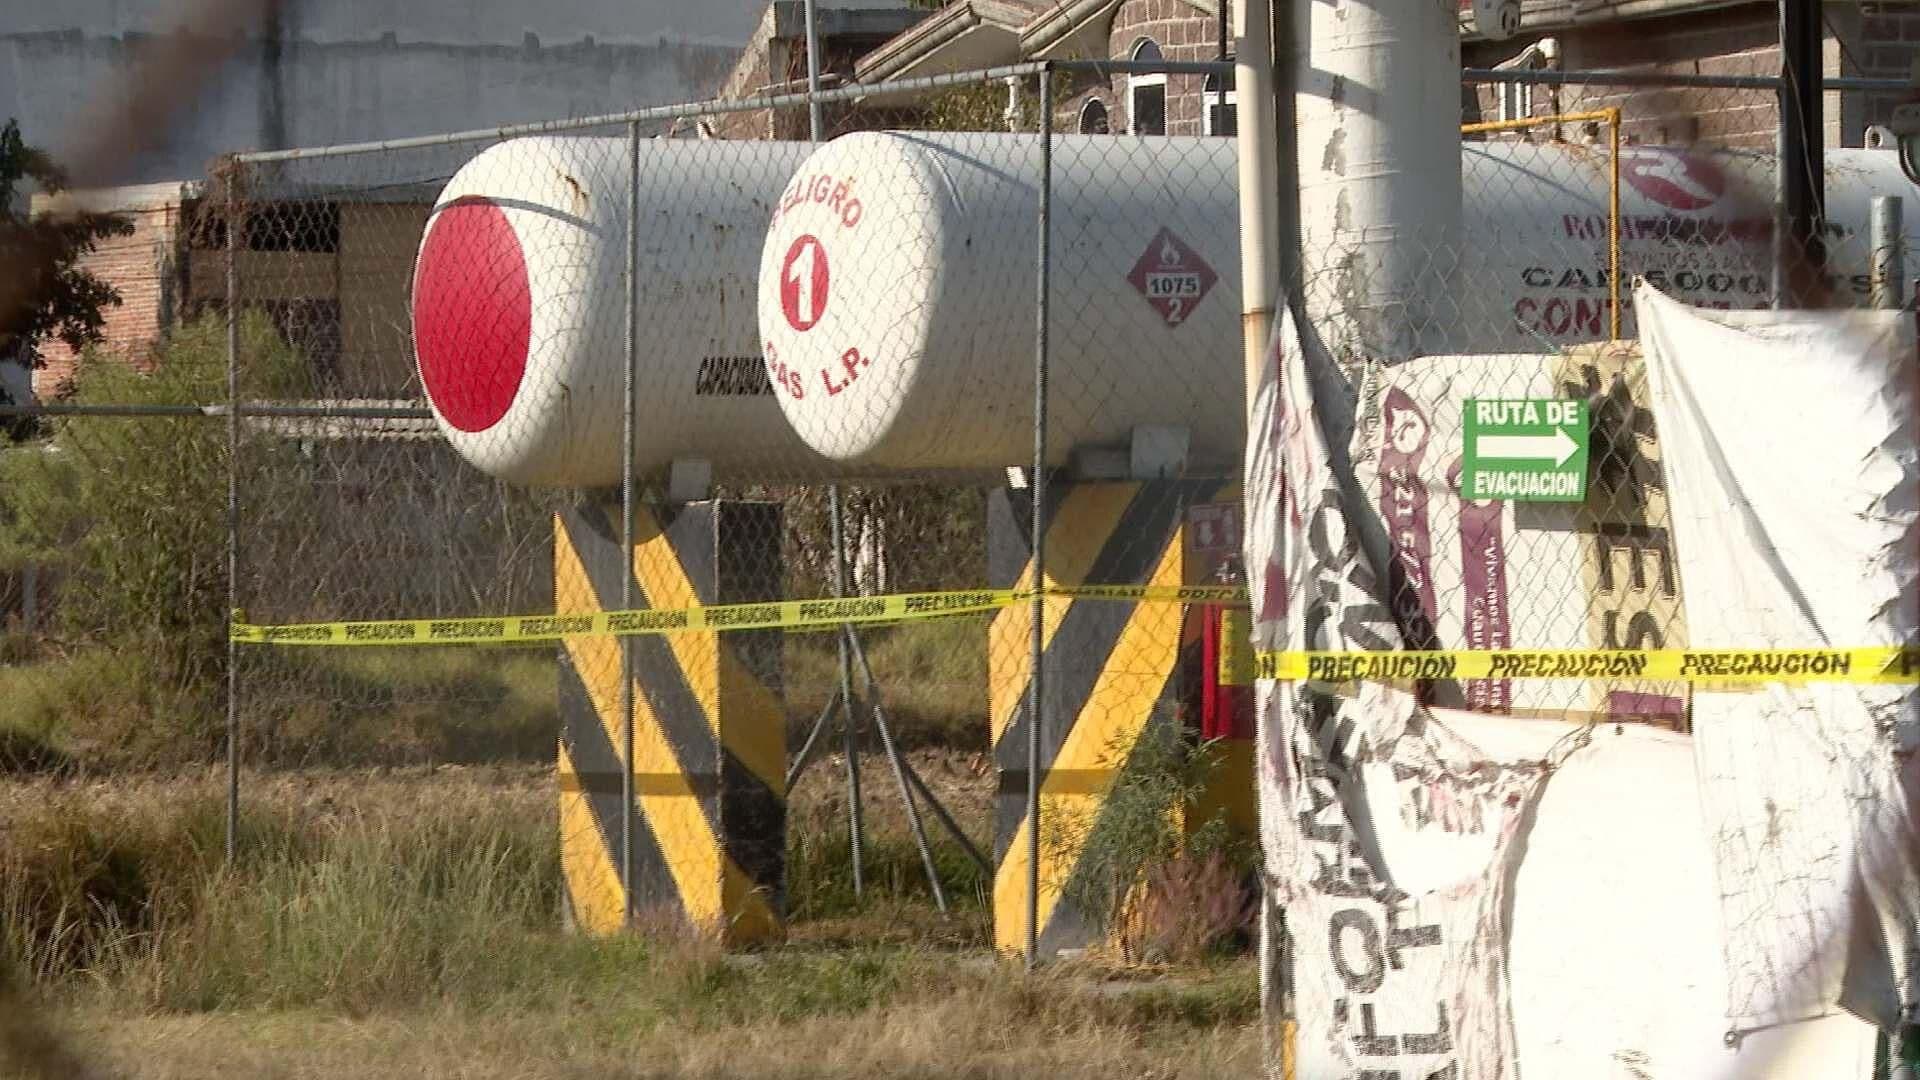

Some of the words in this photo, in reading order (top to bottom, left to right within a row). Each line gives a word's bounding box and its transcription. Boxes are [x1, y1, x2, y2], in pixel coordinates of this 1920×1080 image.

[788, 243, 814, 323] 1
[1150, 277, 1197, 294] 1075
[1168, 298, 1184, 322] 2
[820, 347, 869, 397] L.P.
[1476, 401, 1541, 426] RUTA
[1546, 401, 1579, 426] DE
[1474, 471, 1580, 496] EVACUACION
[1308, 655, 1457, 680] PRECAUCIÓN
[1488, 651, 1648, 678] PRECAUCIÓN
[1680, 651, 1852, 676] PRECAUCIÓN
